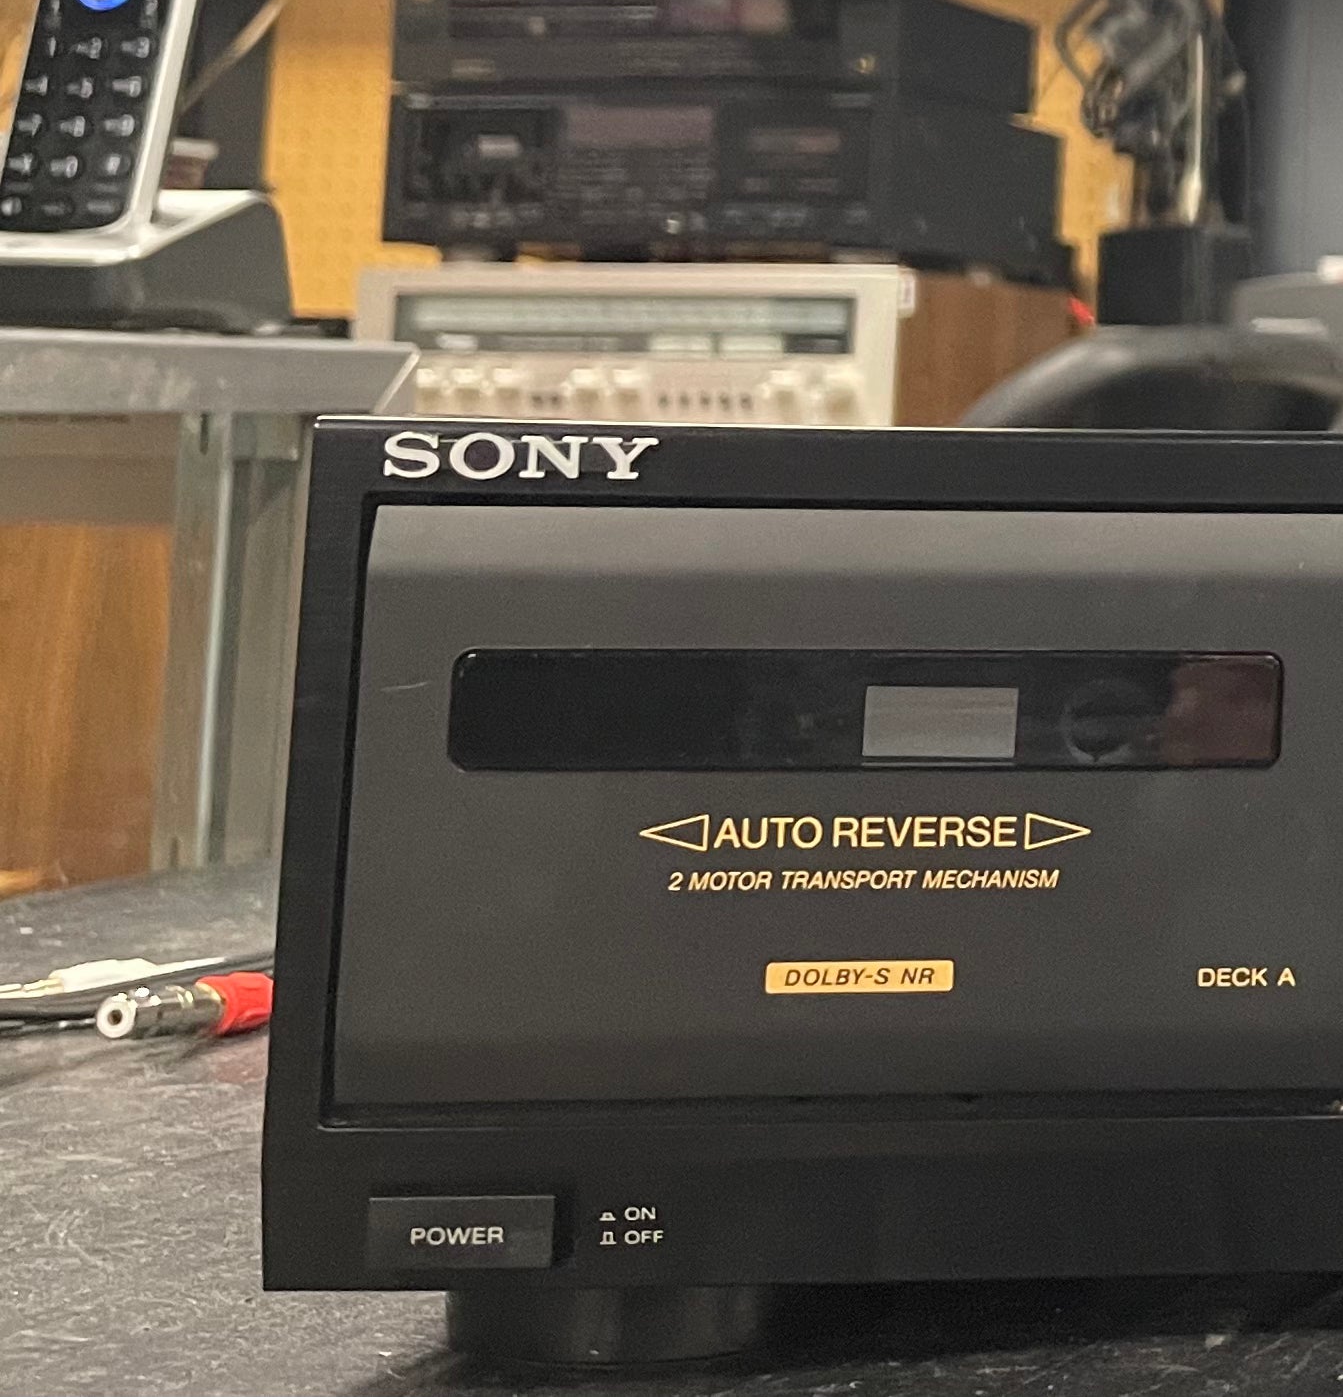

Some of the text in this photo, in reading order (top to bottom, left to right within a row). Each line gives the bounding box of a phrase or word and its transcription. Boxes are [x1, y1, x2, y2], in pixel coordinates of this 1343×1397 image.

[382, 430, 660, 480] SONY
[713, 815, 1018, 849] AUTO REVERSE
[668, 868, 1060, 892] 2 MOTOR TRANSPORT MECHANISM
[784, 967, 935, 988] DOLBY-S NR
[1197, 968, 1297, 988] DECK A
[623, 1206, 657, 1221] ON
[410, 1227, 505, 1246] POWER
[623, 1229, 665, 1246] OFF
